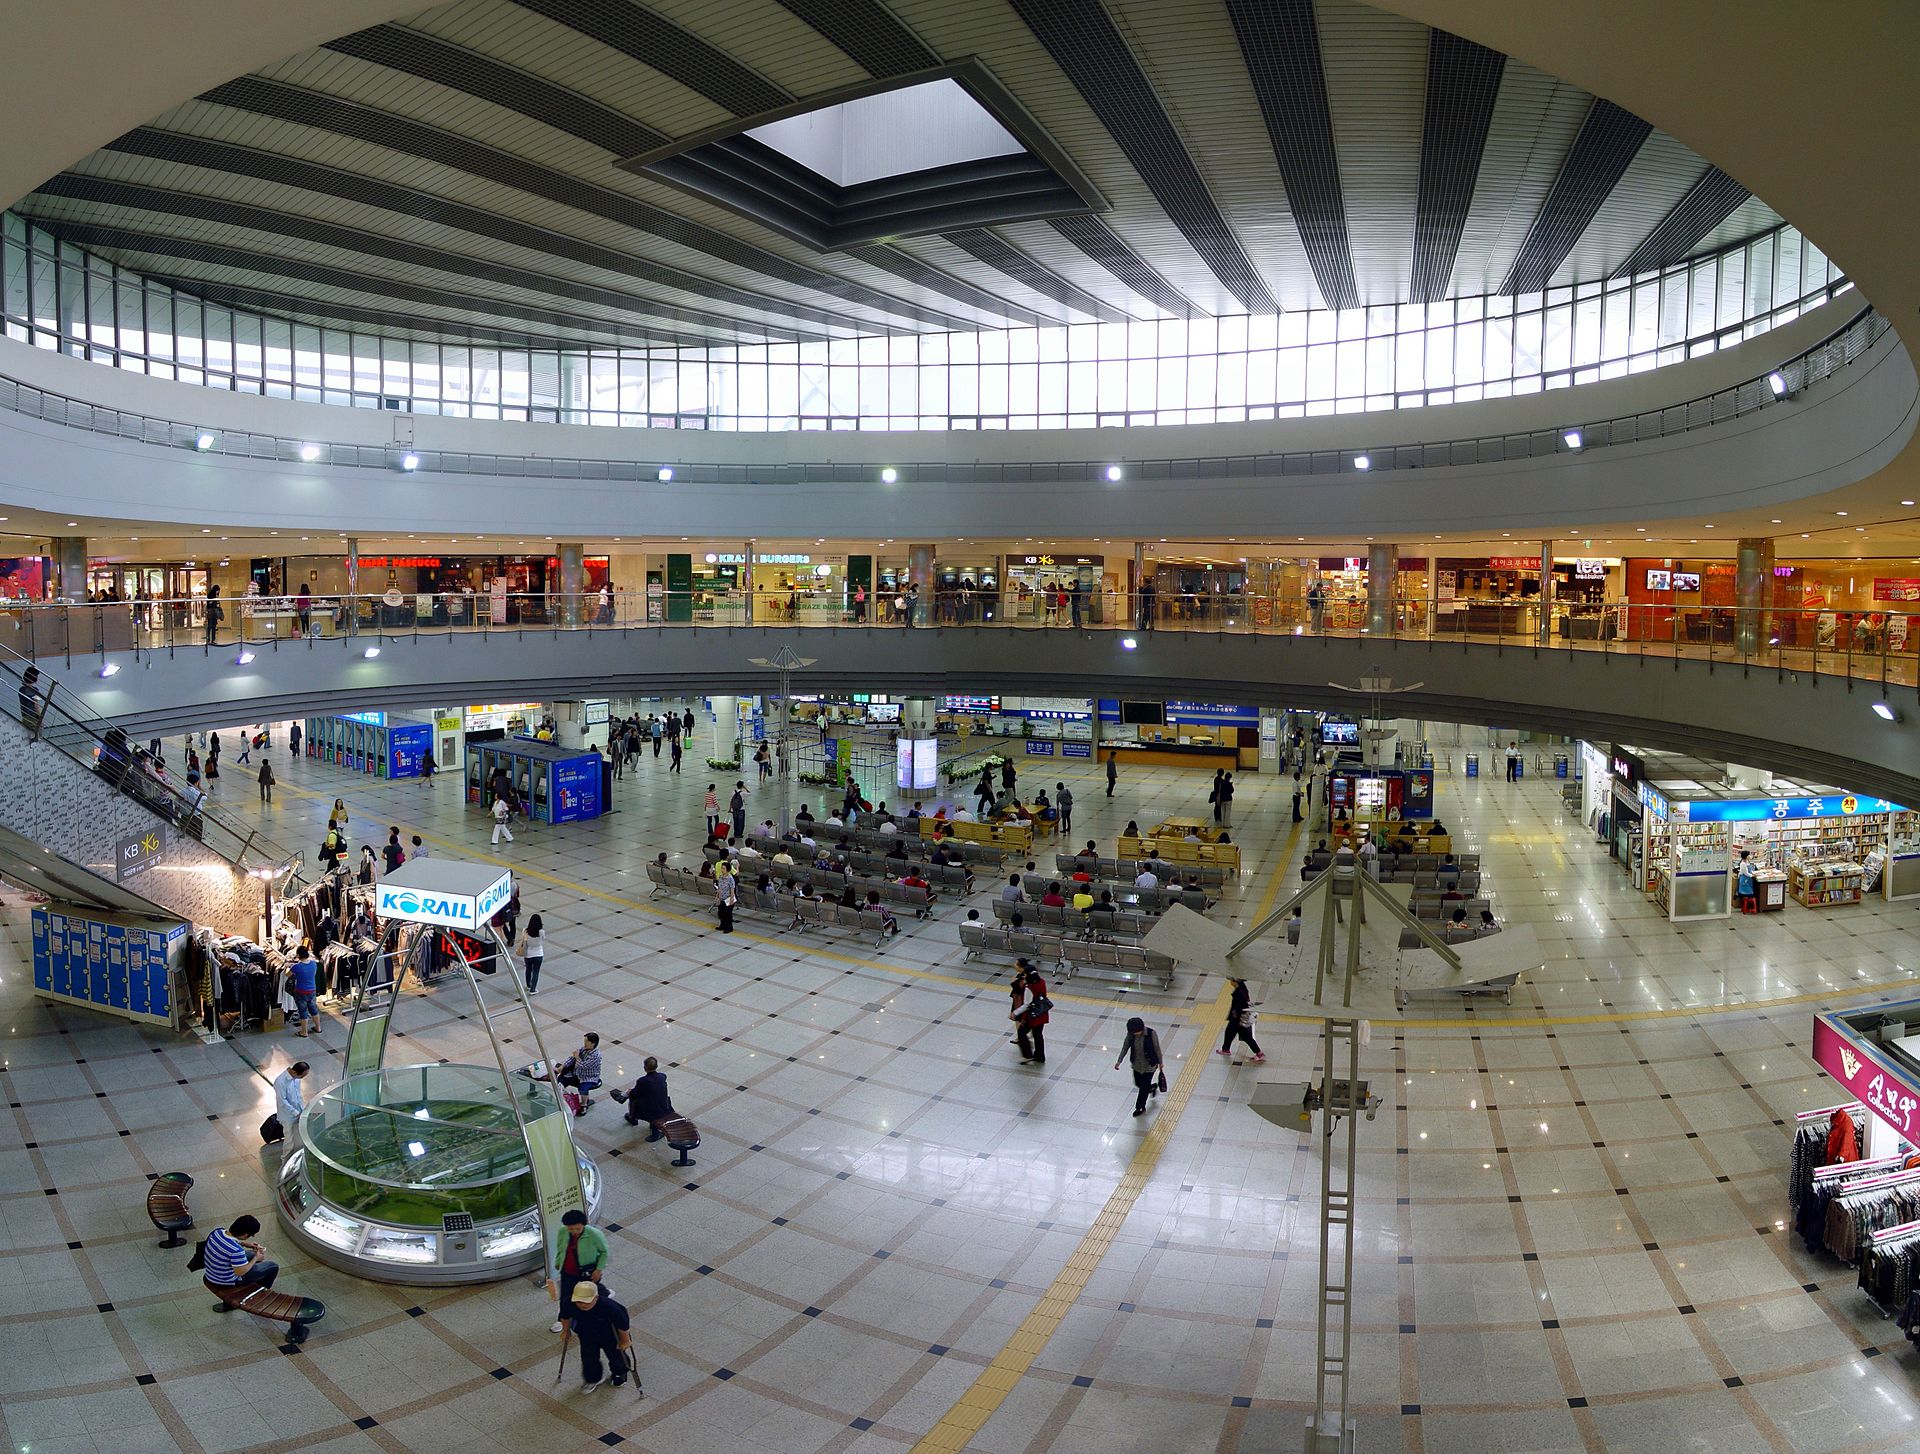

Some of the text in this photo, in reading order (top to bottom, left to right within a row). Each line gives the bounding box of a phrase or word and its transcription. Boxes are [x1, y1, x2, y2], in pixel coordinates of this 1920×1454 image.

[760, 554, 810, 563] BURGERS
[1025, 556, 1037, 564] KB
[1575, 558, 1604, 574] tea
[124, 844, 138, 860] KB
[382, 892, 472, 919] KORAIL
[478, 879, 510, 918] KORAIL
[1867, 1092, 1902, 1126] Collection
